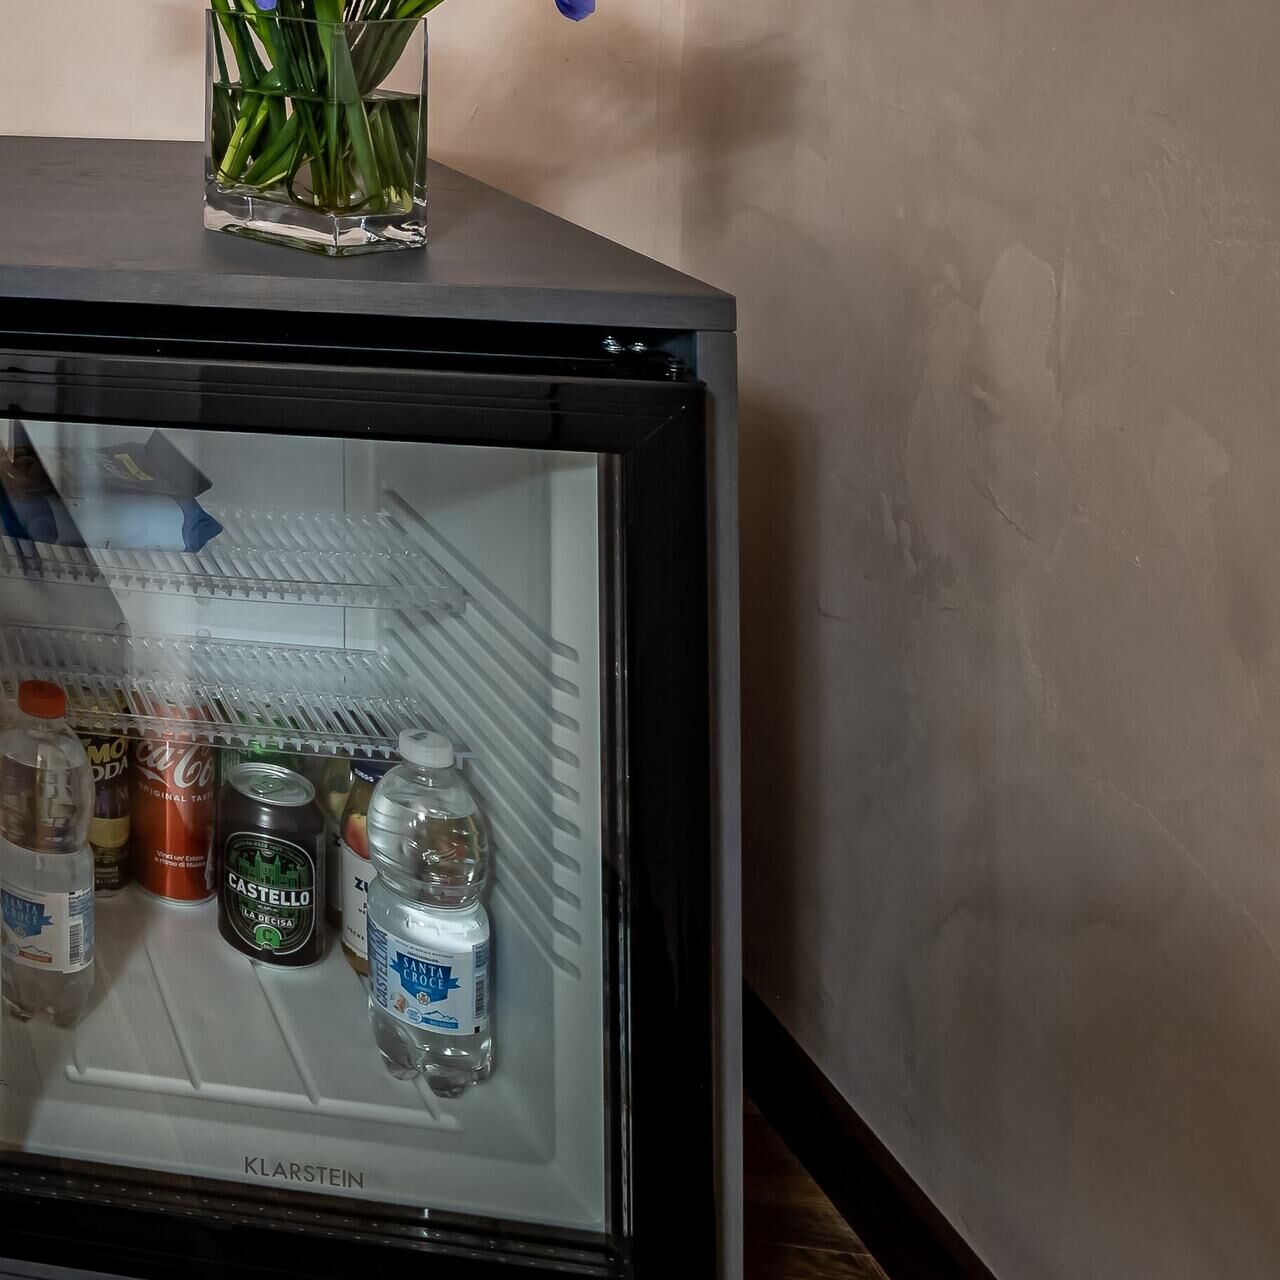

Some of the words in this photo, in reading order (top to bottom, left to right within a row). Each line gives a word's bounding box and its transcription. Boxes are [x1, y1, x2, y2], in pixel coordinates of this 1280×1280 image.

[228, 872, 310, 906] CASTELLO
[244, 909, 255, 919] LA
[258, 914, 292, 927] DECISA
[404, 957, 444, 979] SANTA
[404, 969, 445, 990] CROCE
[243, 1156, 365, 1190] KLARSTEIN
